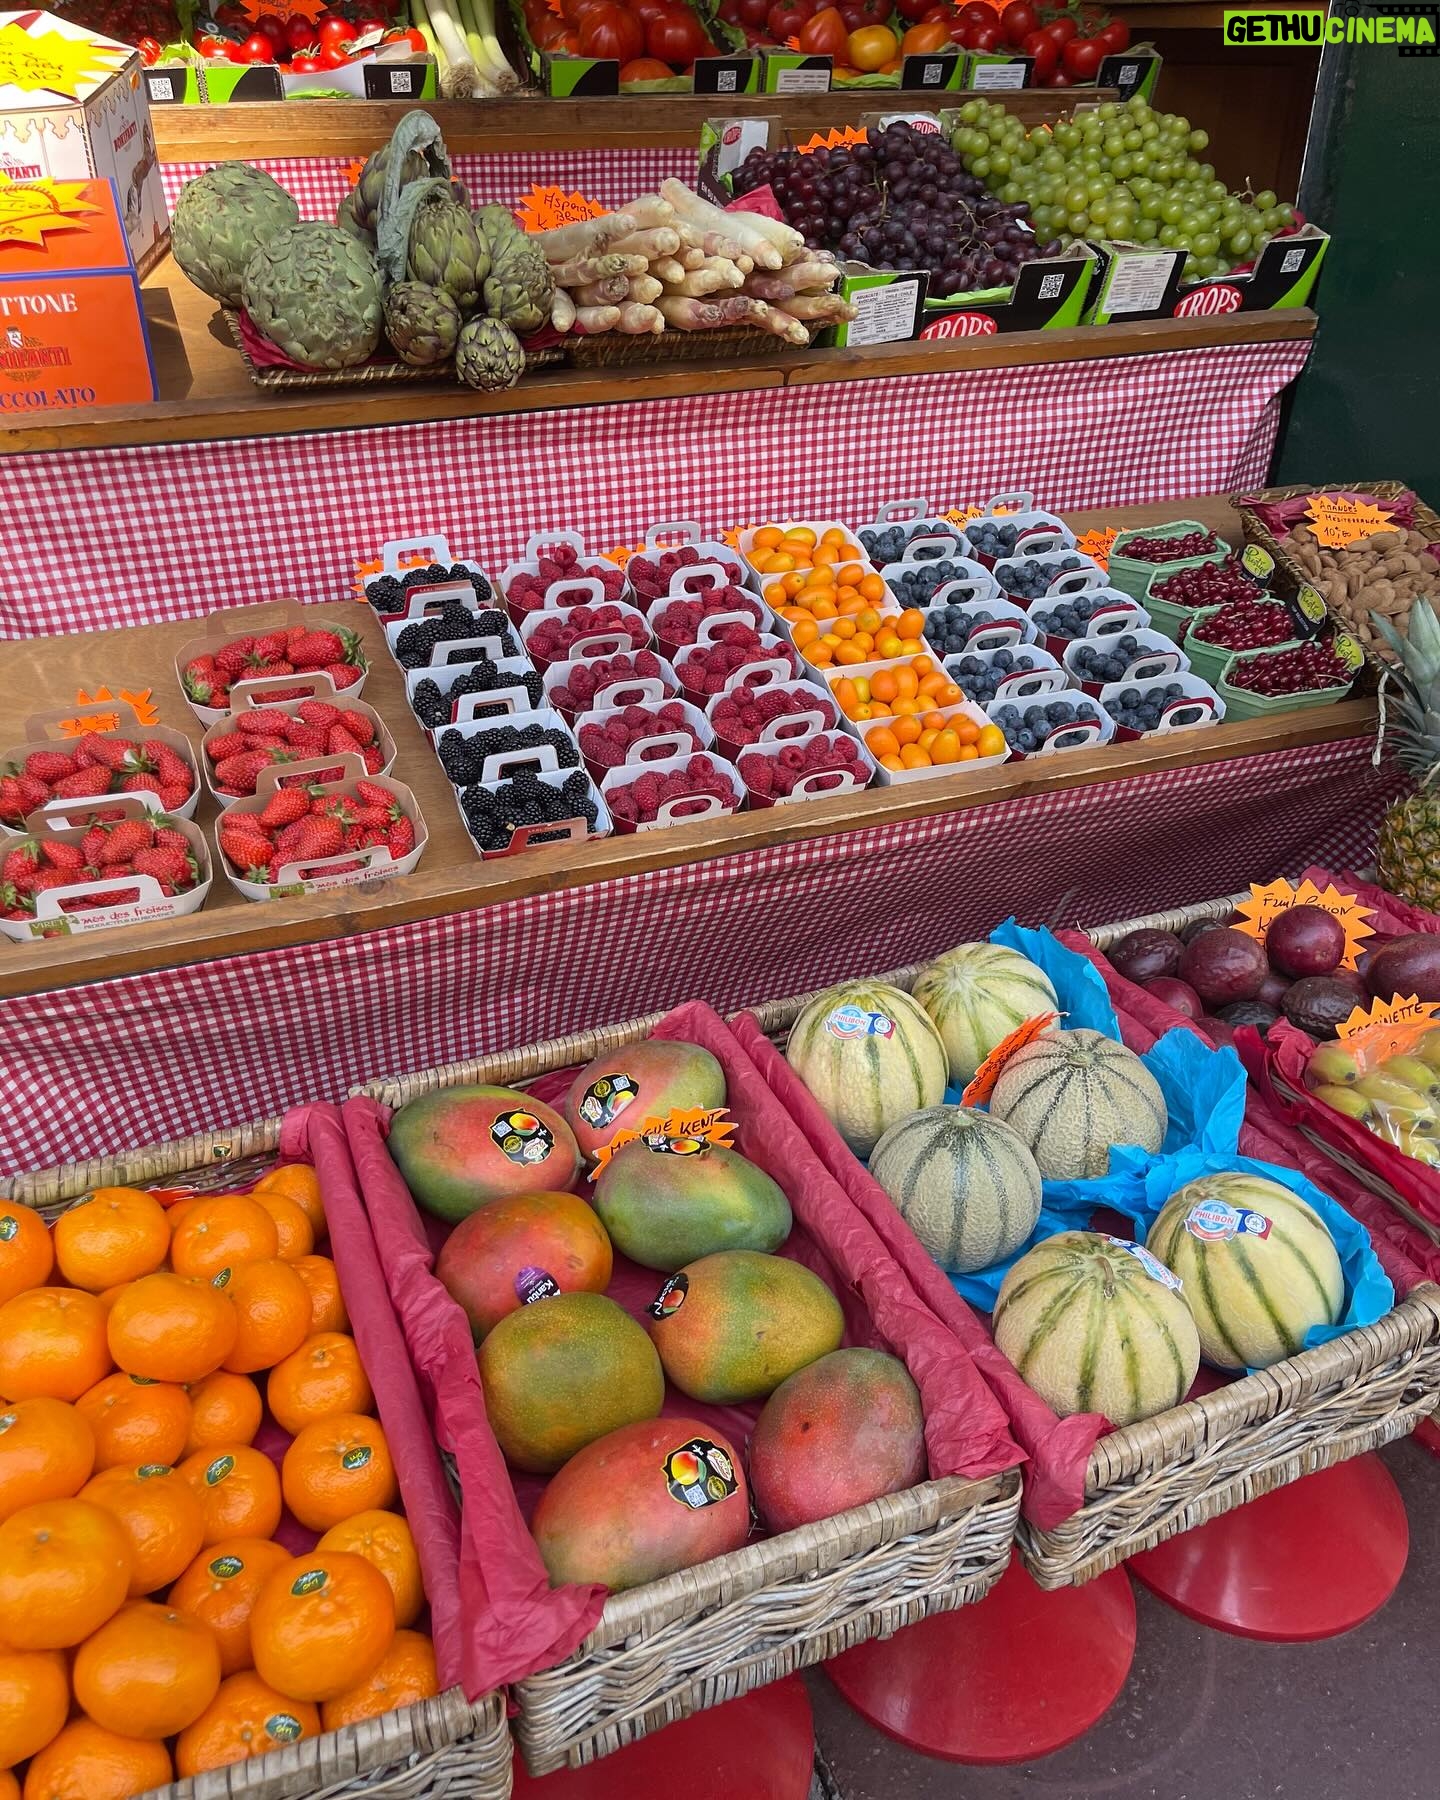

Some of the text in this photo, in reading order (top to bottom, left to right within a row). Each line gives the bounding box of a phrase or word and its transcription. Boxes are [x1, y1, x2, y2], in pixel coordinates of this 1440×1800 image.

[1178, 286, 1241, 319] TROPS
[110, 911, 131, 922] des
[833, 1013, 867, 1026] PHILIBON
[680, 1109, 722, 1137] KENT
[1194, 1209, 1235, 1225] PHILIBON
[526, 1279, 554, 1304] Kantu
